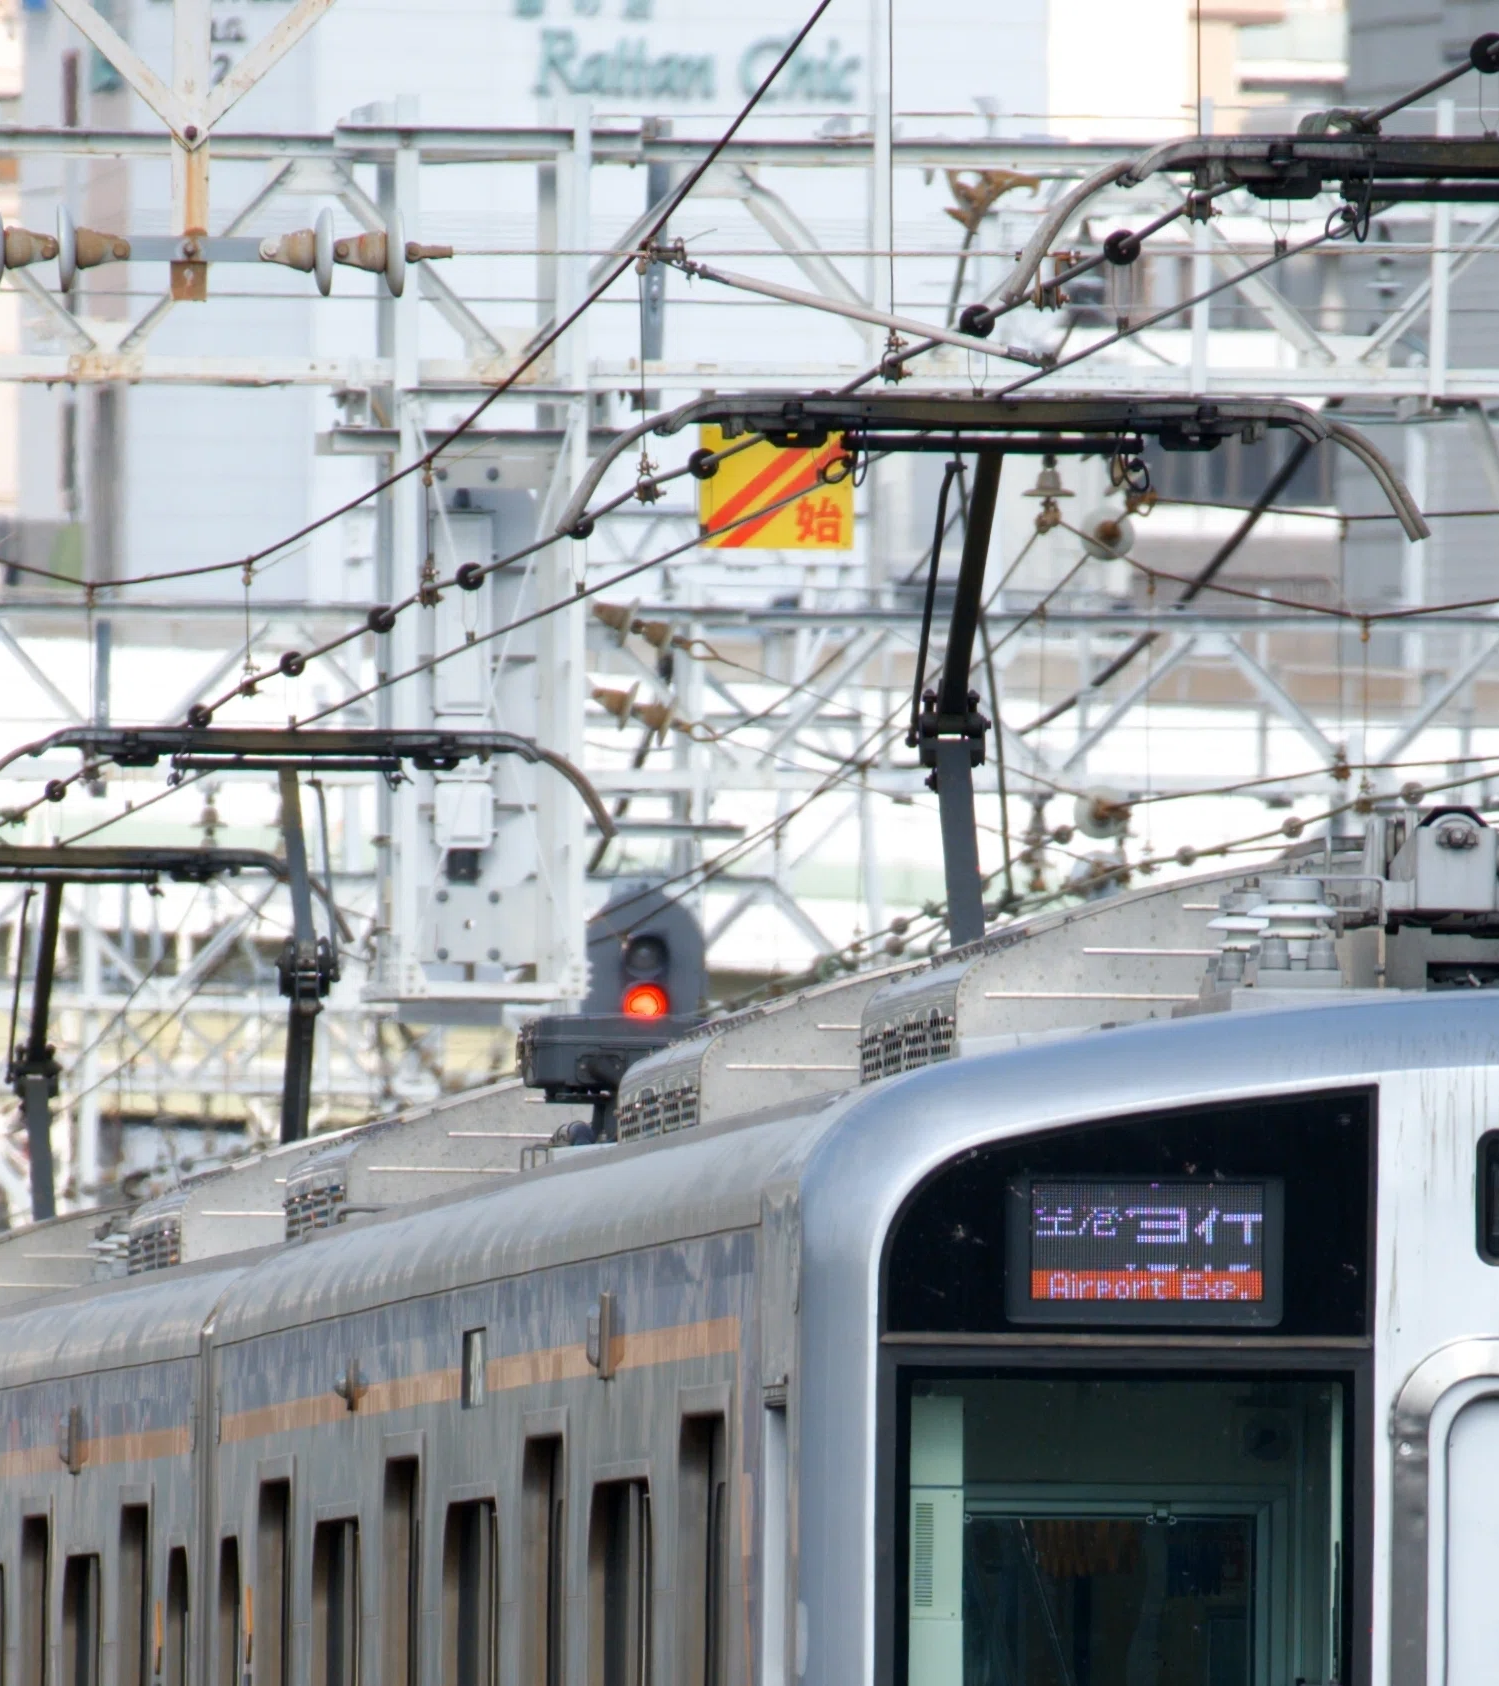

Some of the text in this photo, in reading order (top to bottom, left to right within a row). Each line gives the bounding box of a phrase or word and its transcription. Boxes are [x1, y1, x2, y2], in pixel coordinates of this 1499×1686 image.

[796, 496, 843, 543] 始
[1049, 1272, 1249, 1300] Airport Exp.
